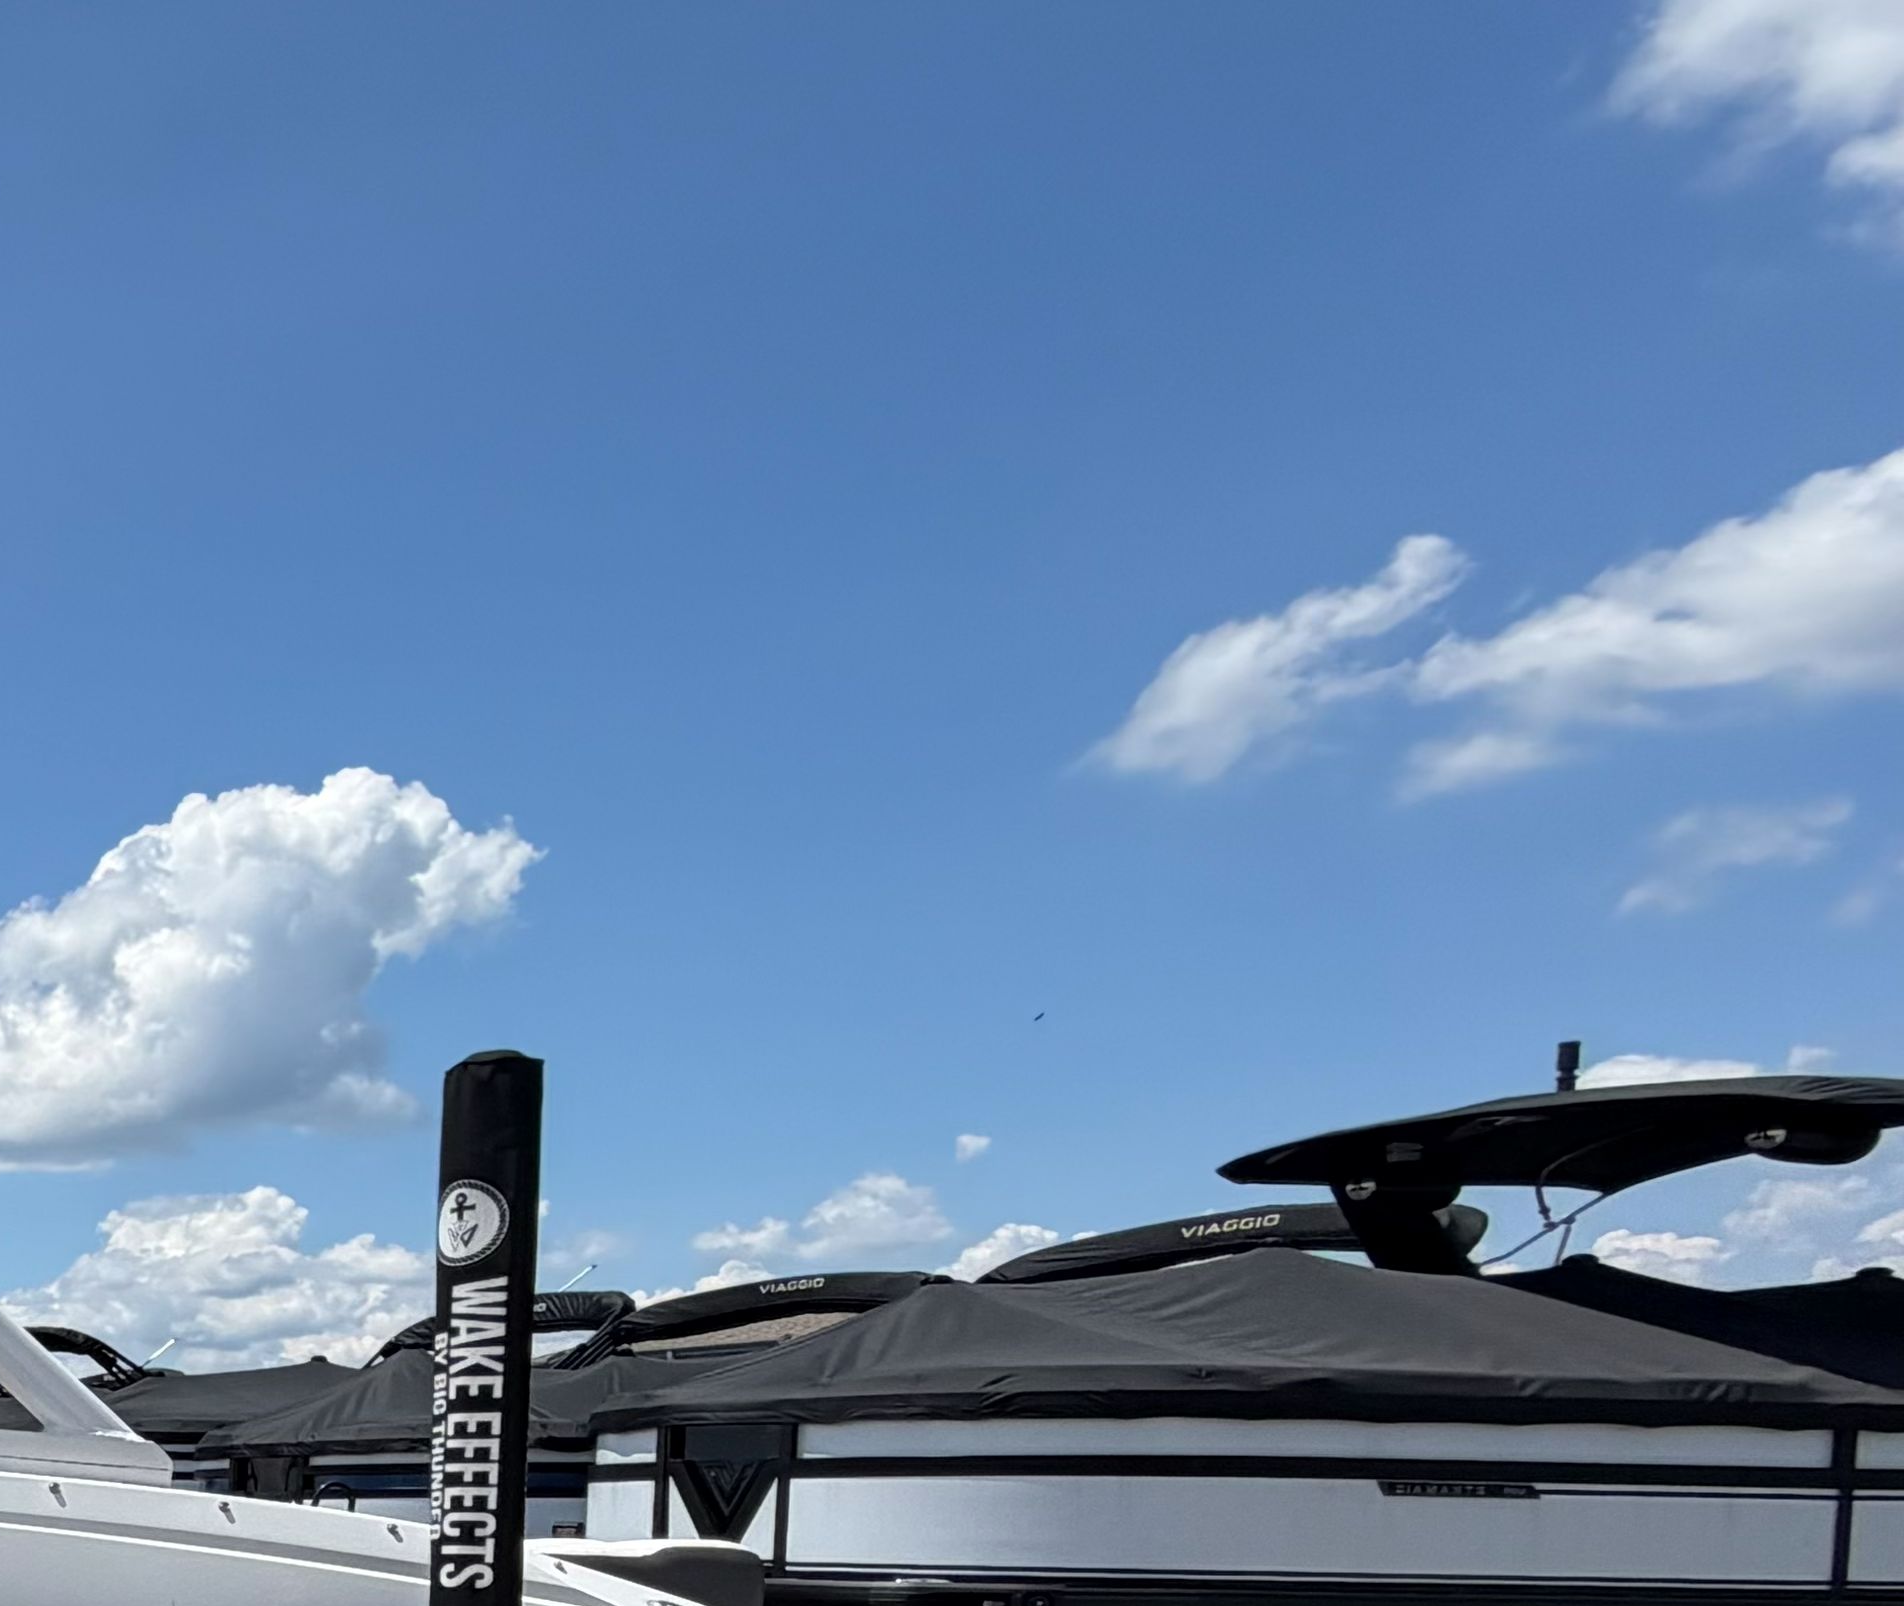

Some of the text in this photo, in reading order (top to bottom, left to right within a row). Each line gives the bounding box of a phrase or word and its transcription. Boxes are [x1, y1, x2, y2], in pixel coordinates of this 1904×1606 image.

[1181, 1213, 1281, 1238] VIAGGIO
[759, 1277, 825, 1294] VIAGGIO
[433, 1331, 449, 1365] BY
[439, 1276, 509, 1589] WAKE EFFECTS
